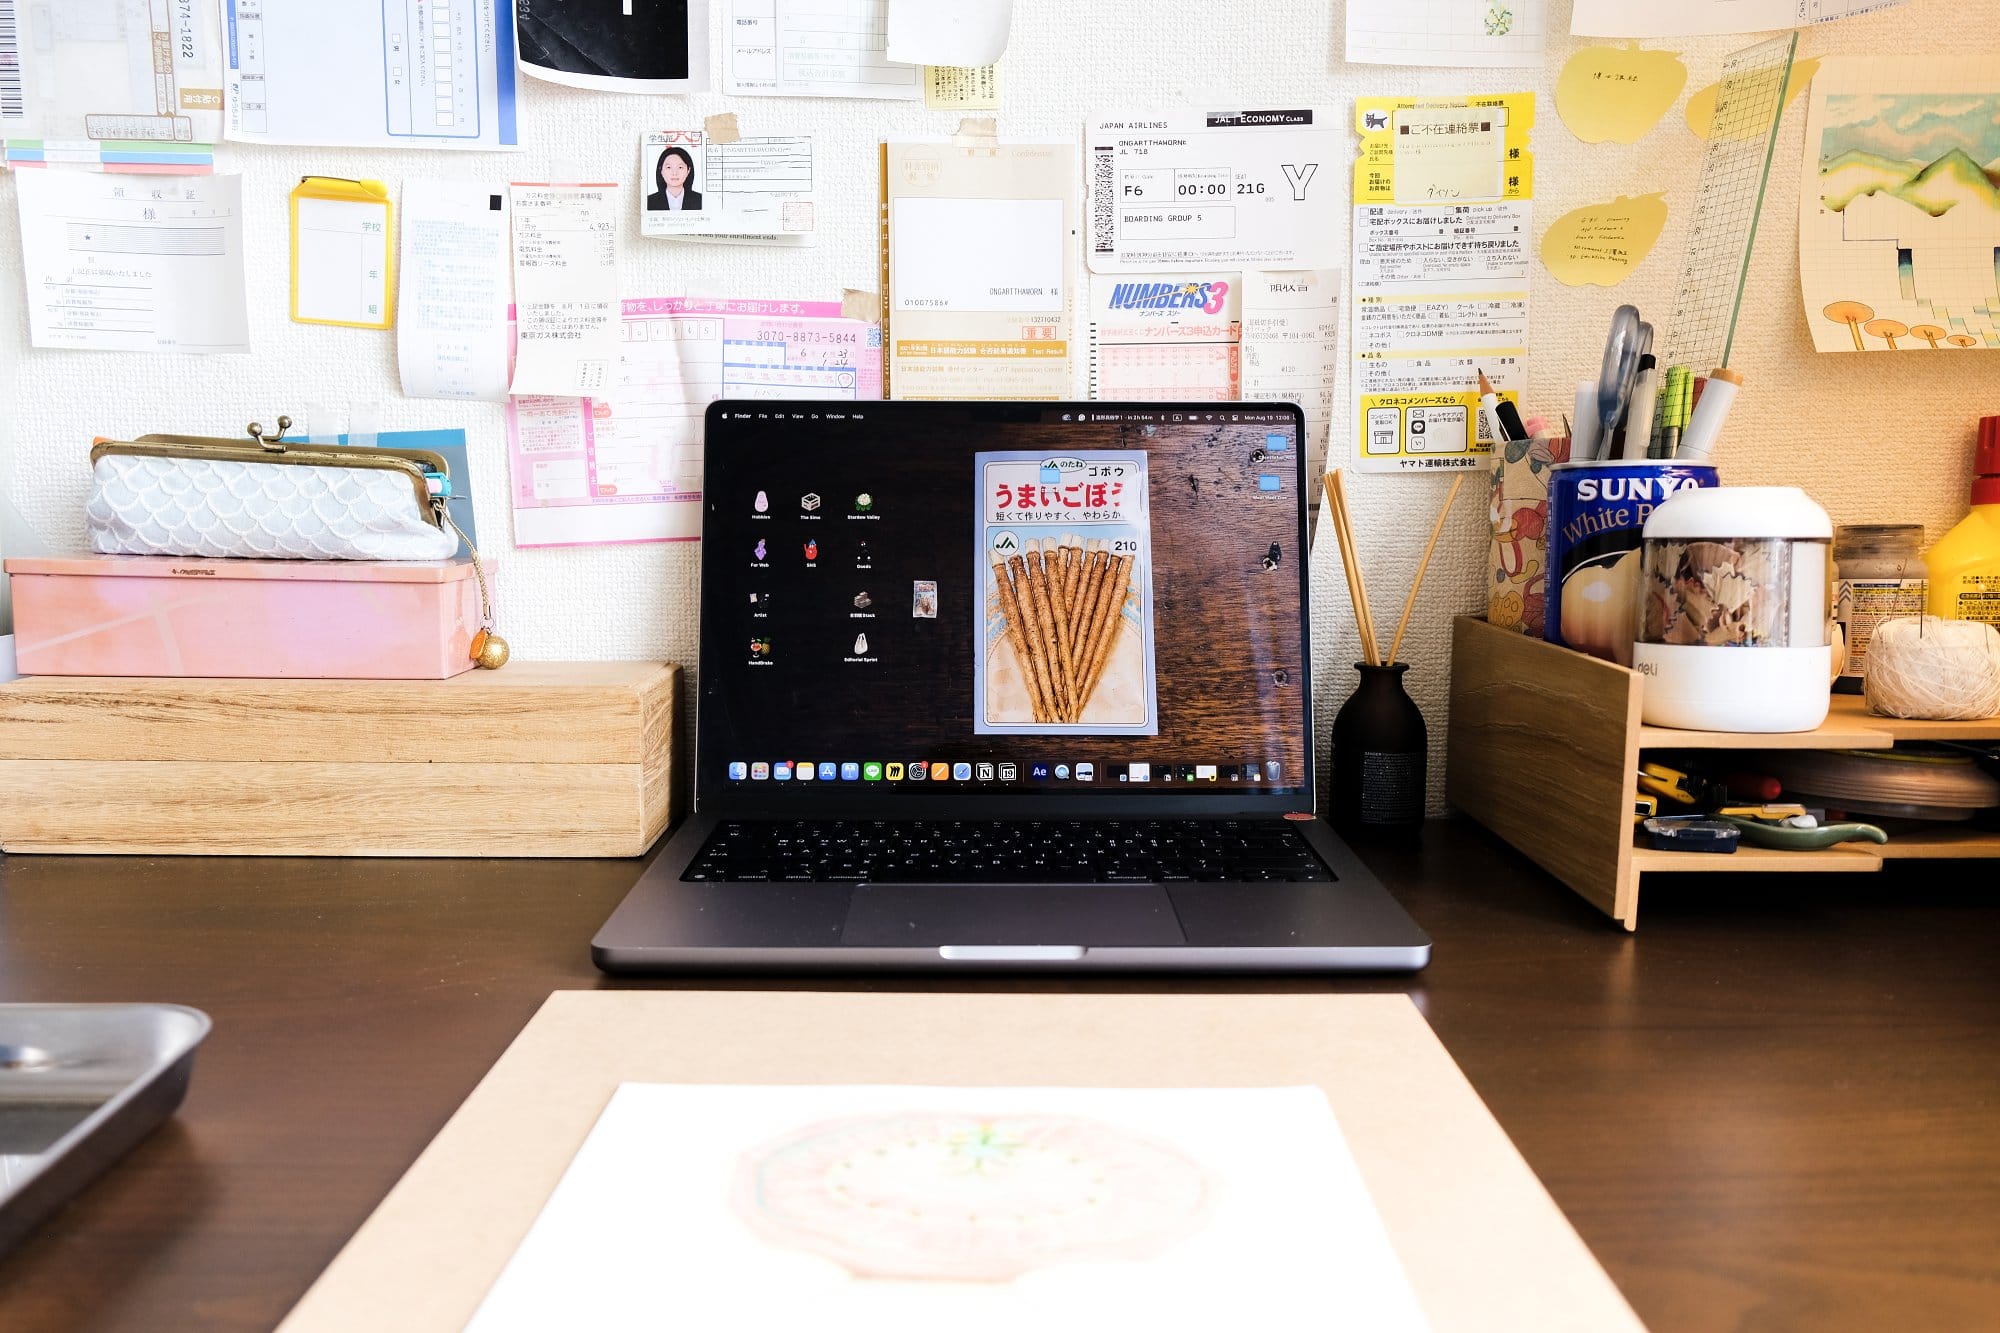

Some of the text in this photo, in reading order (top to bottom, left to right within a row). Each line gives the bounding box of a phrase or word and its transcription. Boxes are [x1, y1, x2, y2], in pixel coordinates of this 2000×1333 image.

[1214, 115, 1231, 124] JAL
[1240, 114, 1285, 123] ECONOMY
[1100, 121, 1168, 130] JAPAN AIRLINES
[1411, 123, 1480, 135] ご不在連絡票
[1508, 148, 1520, 159] 様
[1281, 164, 1318, 201] Y
[1508, 176, 1519, 187] 様
[1124, 185, 1143, 196] F6
[1178, 184, 1226, 195] 00:00
[1237, 183, 1265, 194] 21G
[143, 207, 156, 220] 様
[1124, 214, 1202, 223] BOARDING GROUP 5
[1370, 216, 1463, 226] 宅配ボックスにお届けしました
[362, 222, 382, 232] 学校
[715, 233, 728, 241] your
[1369, 239, 1519, 252] ご指定場所やポストにお届けできず持ち戻りました
[1486, 254, 1519, 262] 立ち入れない
[369, 269, 378, 279] 年
[989, 288, 1043, 296] ONGARTTHAWORN
[1050, 287, 1059, 296] 様
[368, 304, 378, 315] 組
[527, 323, 600, 331] いただくことはありません。
[1145, 325, 1237, 338] ナンバーズ3申込カード
[521, 331, 581, 340] 東京ガス株式会社
[756, 329, 856, 344] 3070-8873-5844
[1026, 327, 1054, 338] 重要
[1404, 330, 1444, 338] クロネコDM便
[800, 347, 808, 358] 6
[930, 346, 977, 356] 日本語能力試験
[1379, 396, 1456, 406] クロネコメンバーズなら
[1060, 460, 1083, 468] のたね
[1400, 457, 1476, 468] ヤマト運輸株式会社
[1089, 466, 1124, 477] ゴボウ
[996, 511, 1077, 521] 短くて作りやすく、
[1562, 507, 1629, 545] White
[1115, 540, 1137, 551] 210
[1637, 662, 1658, 677] deli
[980, 768, 991, 778] N
[1003, 768, 1013, 778] 19
[1033, 766, 1047, 776] Ae
